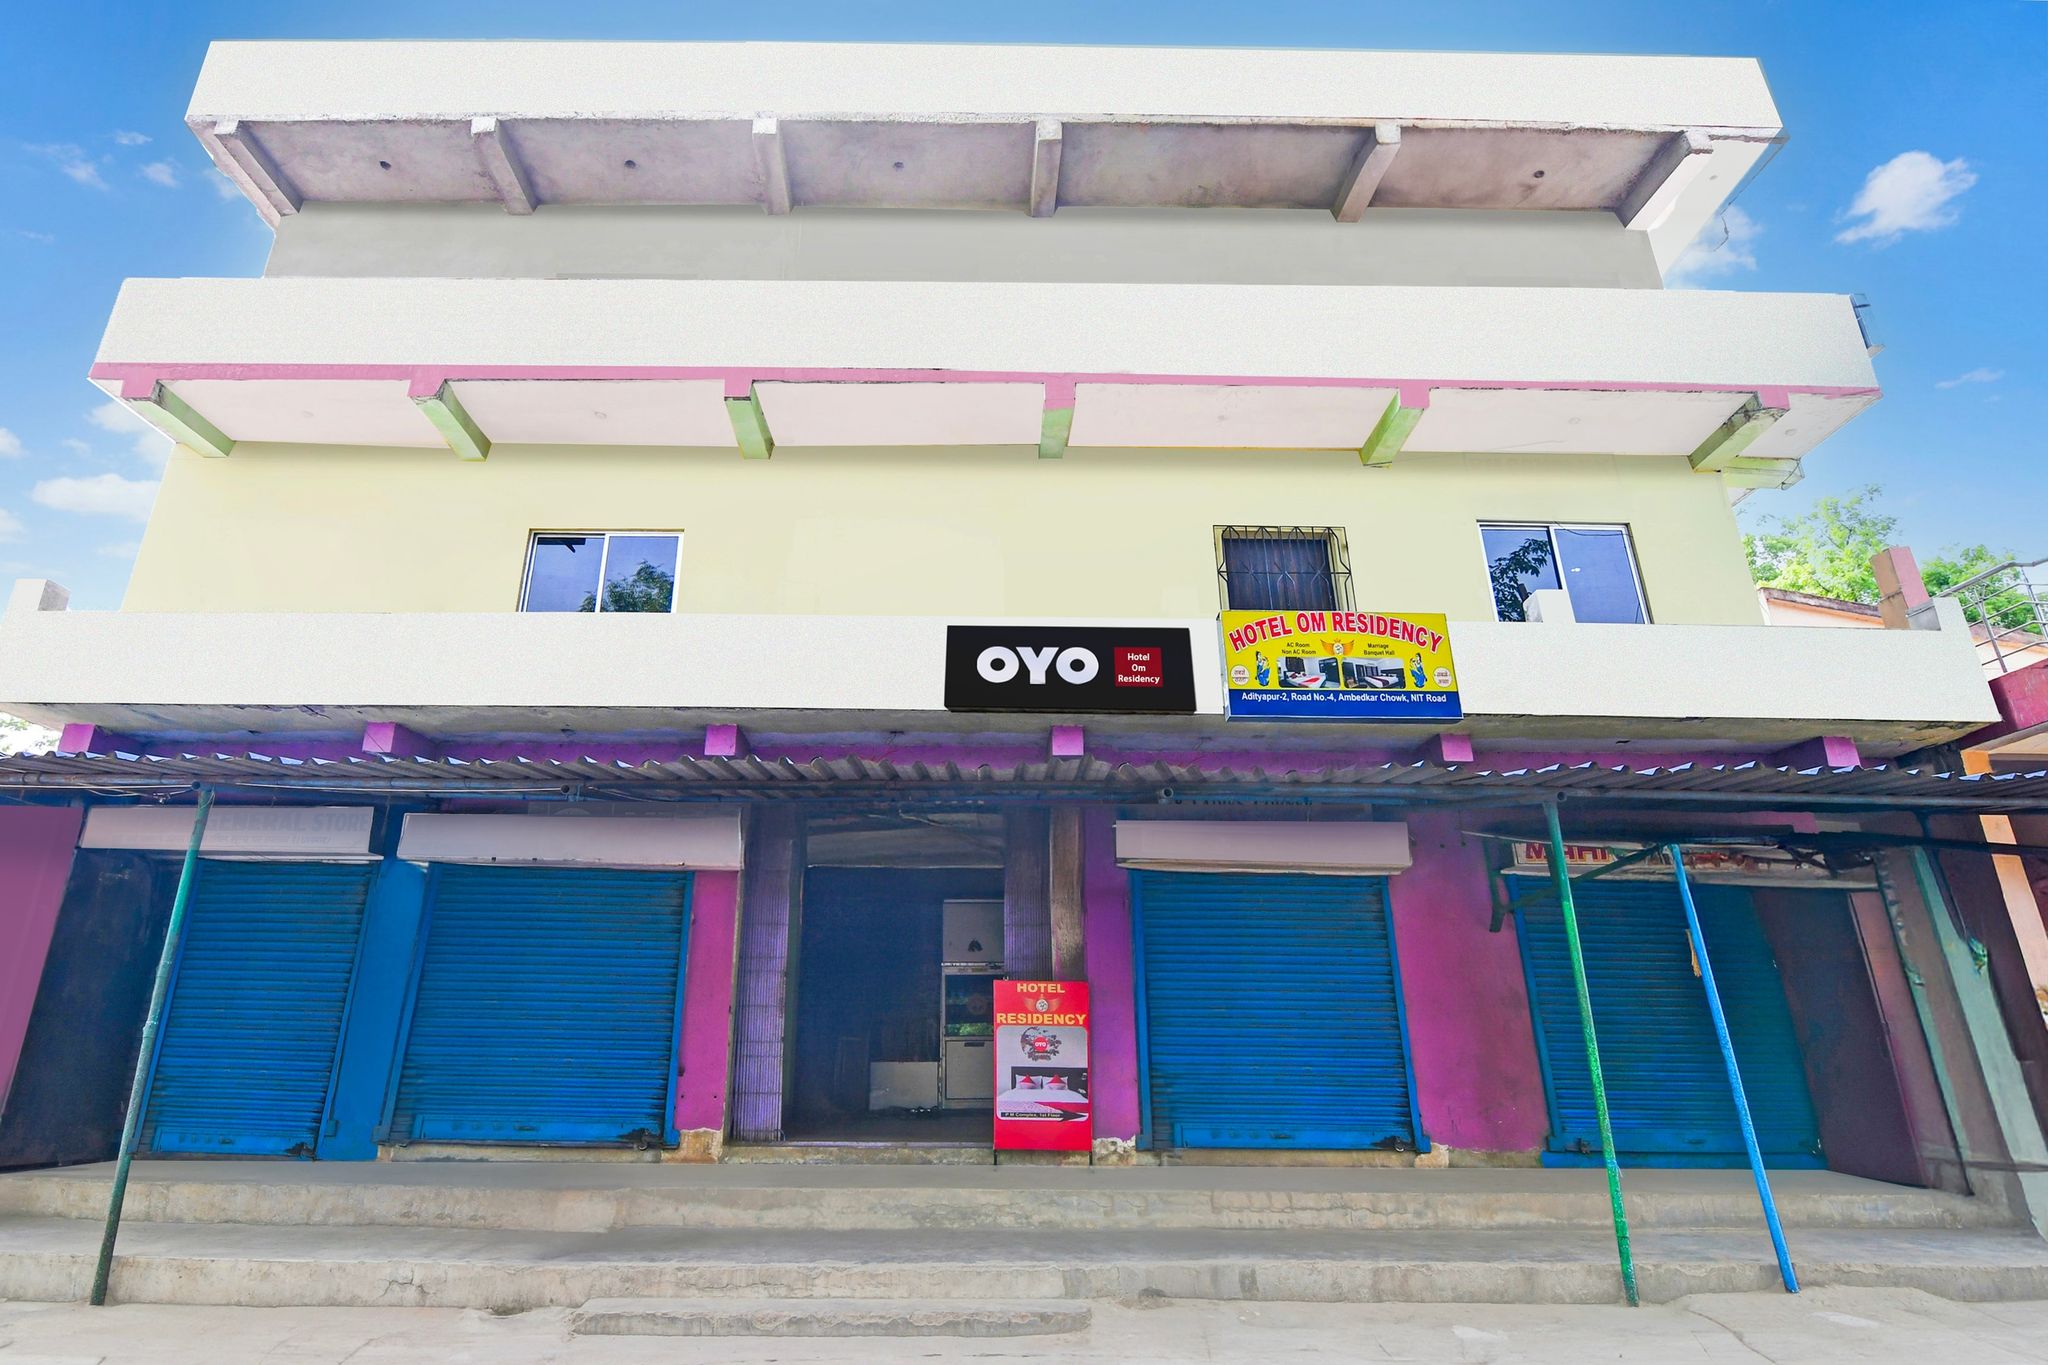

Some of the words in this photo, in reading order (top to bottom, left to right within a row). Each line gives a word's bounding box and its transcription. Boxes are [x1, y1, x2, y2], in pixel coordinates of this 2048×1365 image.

[1228, 614, 1293, 652] HOTEL
[1296, 611, 1327, 633] OM
[1331, 611, 1444, 653] RESIDENCY
[1127, 652, 1150, 661] Hotel
[976, 645, 1100, 685] OYO
[1131, 663, 1146, 672] Om
[1118, 674, 1160, 685] Residency
[1241, 692, 1290, 703] Adityapur-2,
[1291, 692, 1312, 702] Road
[1313, 692, 1337, 703] No.-4,
[1338, 692, 1379, 702] Ambedkar
[1380, 692, 1409, 704] Chowk,
[1410, 693, 1425, 703] NIT
[1426, 693, 1447, 703] Road
[1016, 983, 1065, 994] HOTEL
[996, 1013, 1087, 1025] RESIDENCY
